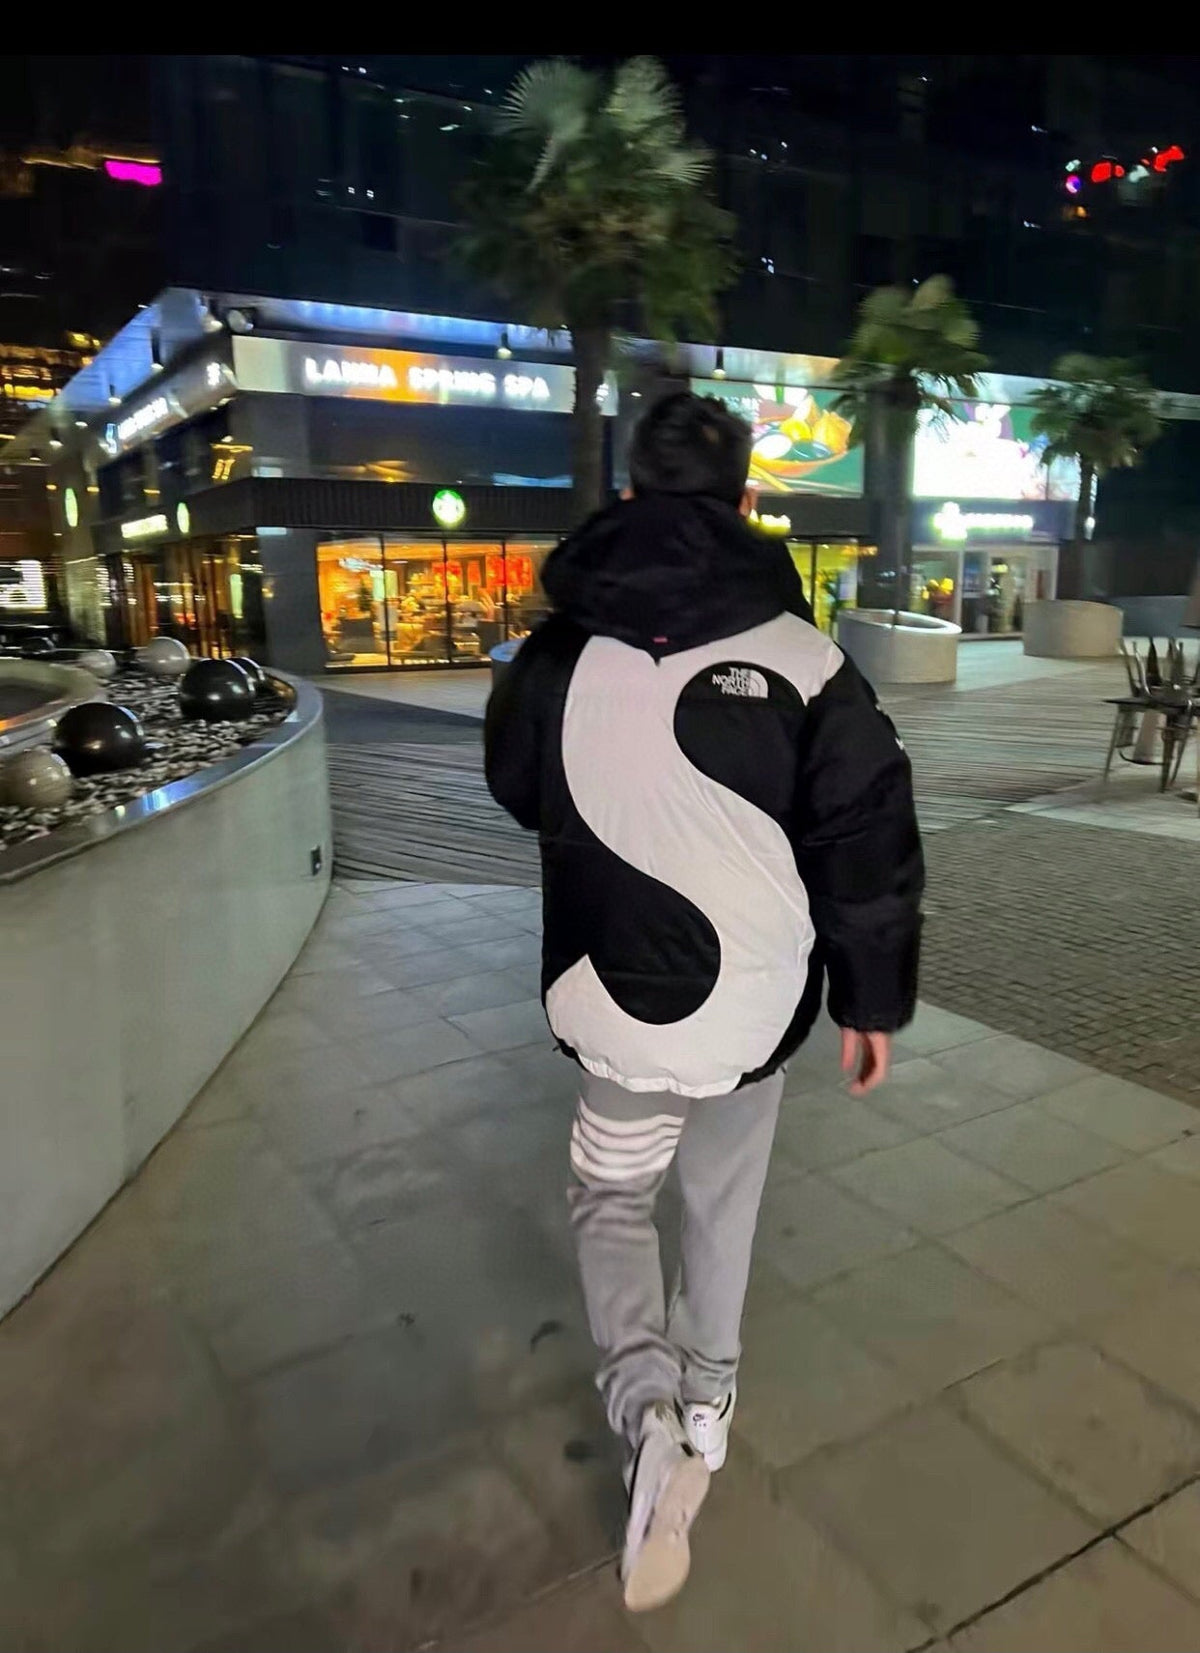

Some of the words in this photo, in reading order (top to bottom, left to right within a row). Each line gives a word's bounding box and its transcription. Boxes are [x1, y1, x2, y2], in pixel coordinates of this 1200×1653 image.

[504, 373, 550, 399] SPA
[729, 667, 750, 679] THE
[712, 674, 750, 688] NORTH
[721, 684, 750, 697] FACE
